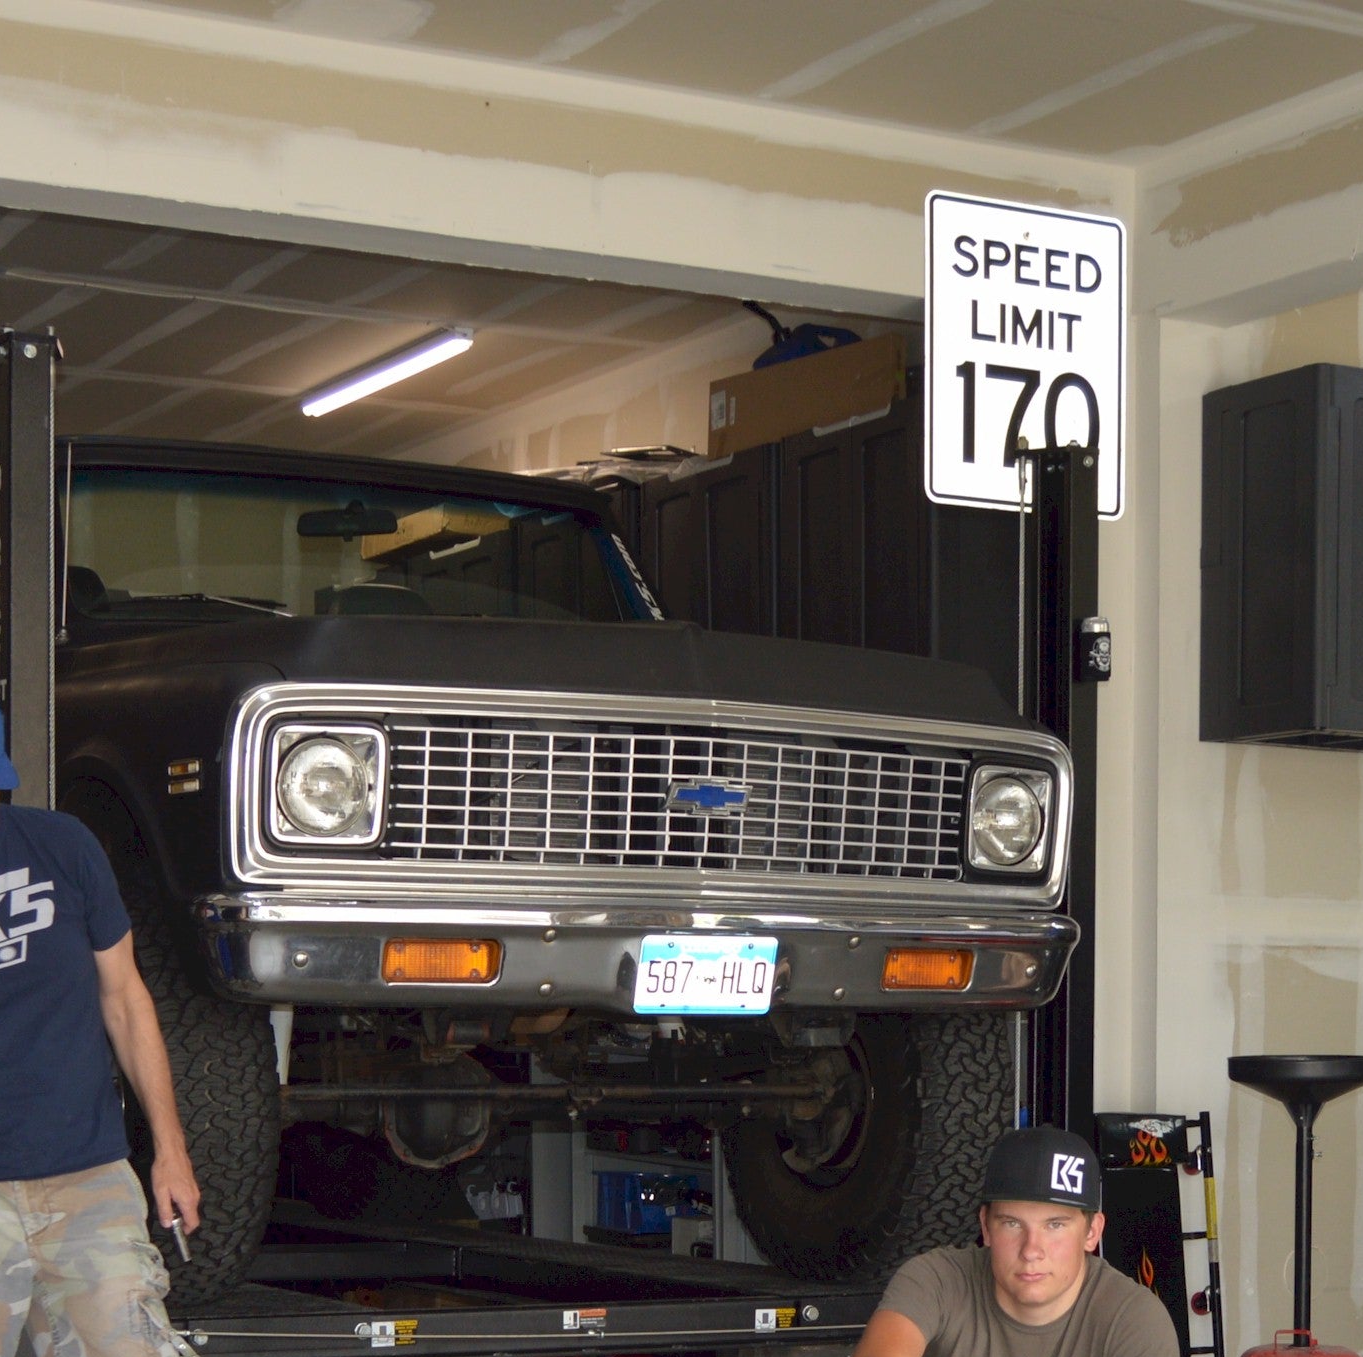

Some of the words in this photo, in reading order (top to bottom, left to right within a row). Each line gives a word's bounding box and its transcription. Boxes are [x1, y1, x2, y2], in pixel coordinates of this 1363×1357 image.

[952, 235, 1102, 293] SPEED
[971, 299, 1082, 353] LIMIT
[956, 360, 1100, 468] 170
[646, 960, 694, 994] 587
[720, 961, 767, 994] HLQ
